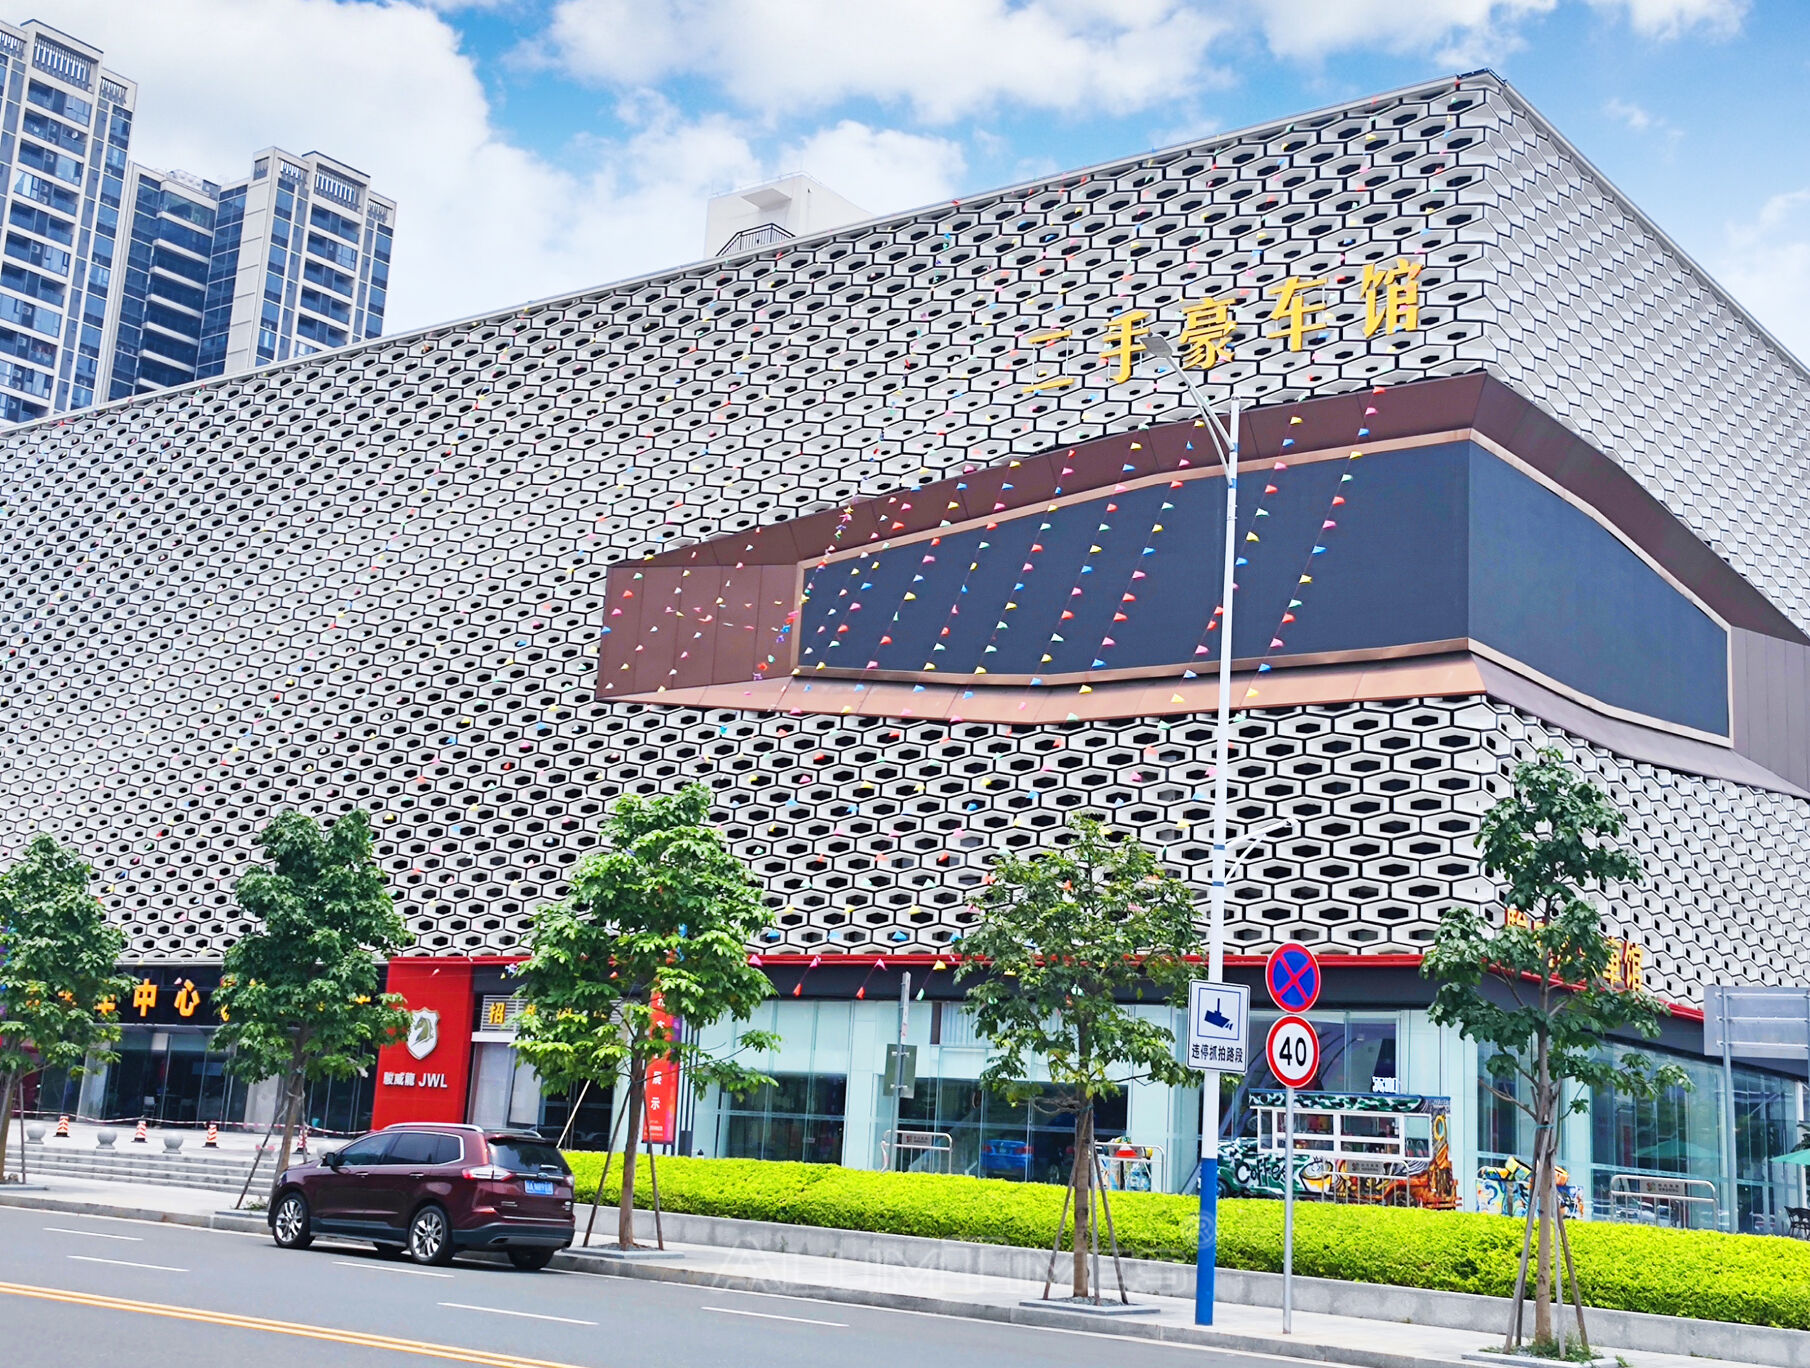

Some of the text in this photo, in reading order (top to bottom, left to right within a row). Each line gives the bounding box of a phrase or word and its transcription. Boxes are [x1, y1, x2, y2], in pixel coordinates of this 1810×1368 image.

[1021, 258, 1424, 393] 二手豪车馆
[1191, 1043, 1243, 1064] 违停抓拍路段
[1279, 1036, 1307, 1067] 40
[418, 1072, 448, 1088] JWL
